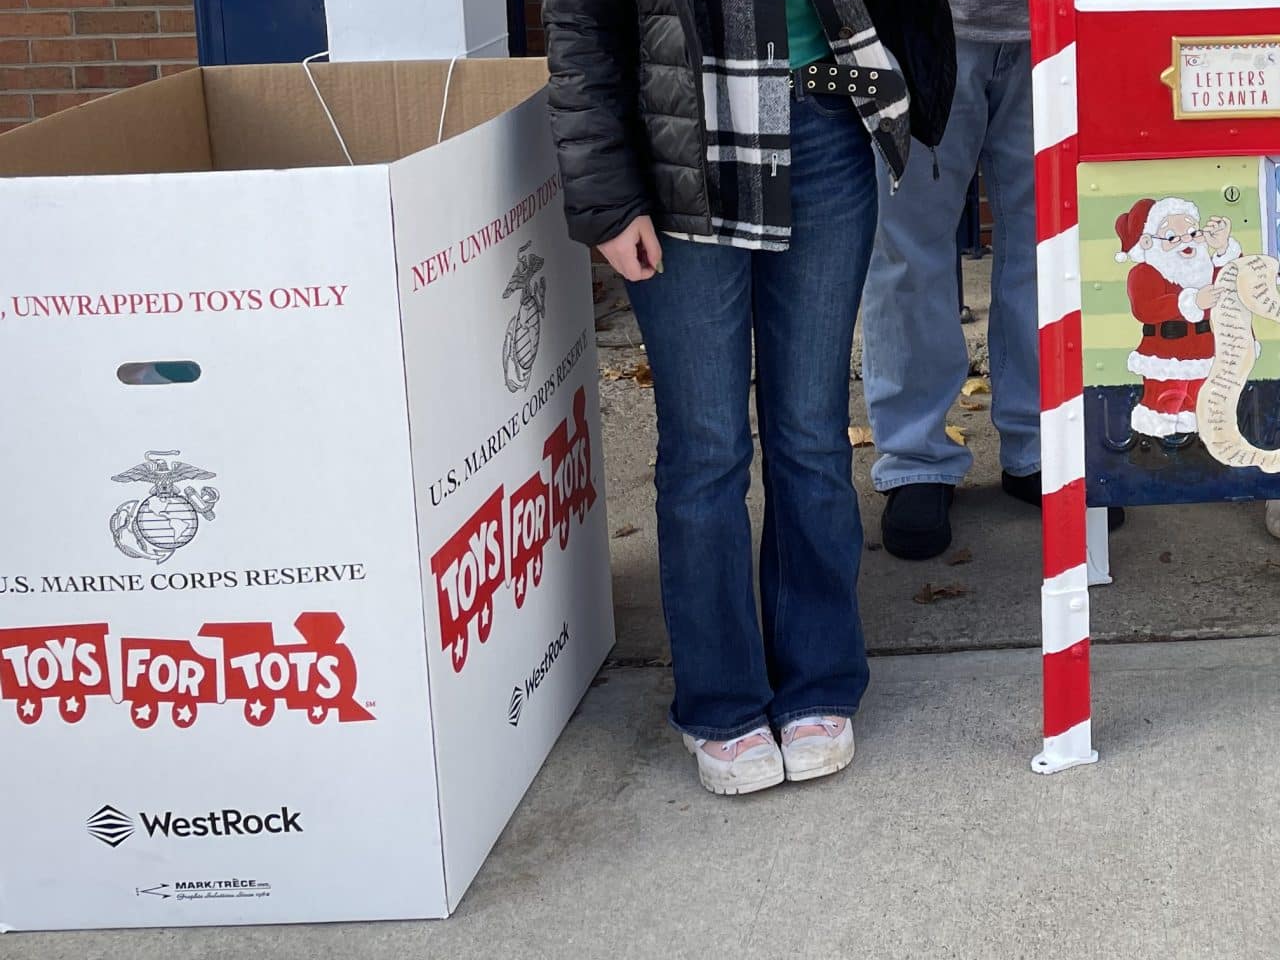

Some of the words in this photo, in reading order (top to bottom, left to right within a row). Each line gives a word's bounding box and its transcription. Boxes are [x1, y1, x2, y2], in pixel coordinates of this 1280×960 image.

[1192, 91, 1211, 108] TO
[1217, 89, 1269, 107] SANTA
[1196, 70, 1266, 88] LETTERS
[411, 246, 457, 292] NEW,
[459, 194, 537, 263] UNWRAPPED
[11, 291, 184, 318] UNWRAPPED
[189, 288, 264, 313] TOYS
[269, 285, 348, 309] ONLY
[428, 468, 462, 507] U.S.
[464, 412, 520, 482] MARINE
[521, 375, 555, 426] CORPS
[555, 328, 588, 386] RESERVE
[441, 520, 501, 621] TOYS
[512, 494, 545, 559] FOR
[554, 437, 588, 506] TOTS
[42, 574, 144, 593] MARINE
[150, 570, 238, 591] CORPS
[245, 563, 366, 587] RESERVE
[2, 637, 101, 690] TOYS
[126, 648, 205, 697] FOR
[230, 651, 342, 700] TOTS
[525, 621, 571, 700] WestRock
[138, 806, 304, 838] WestRock
